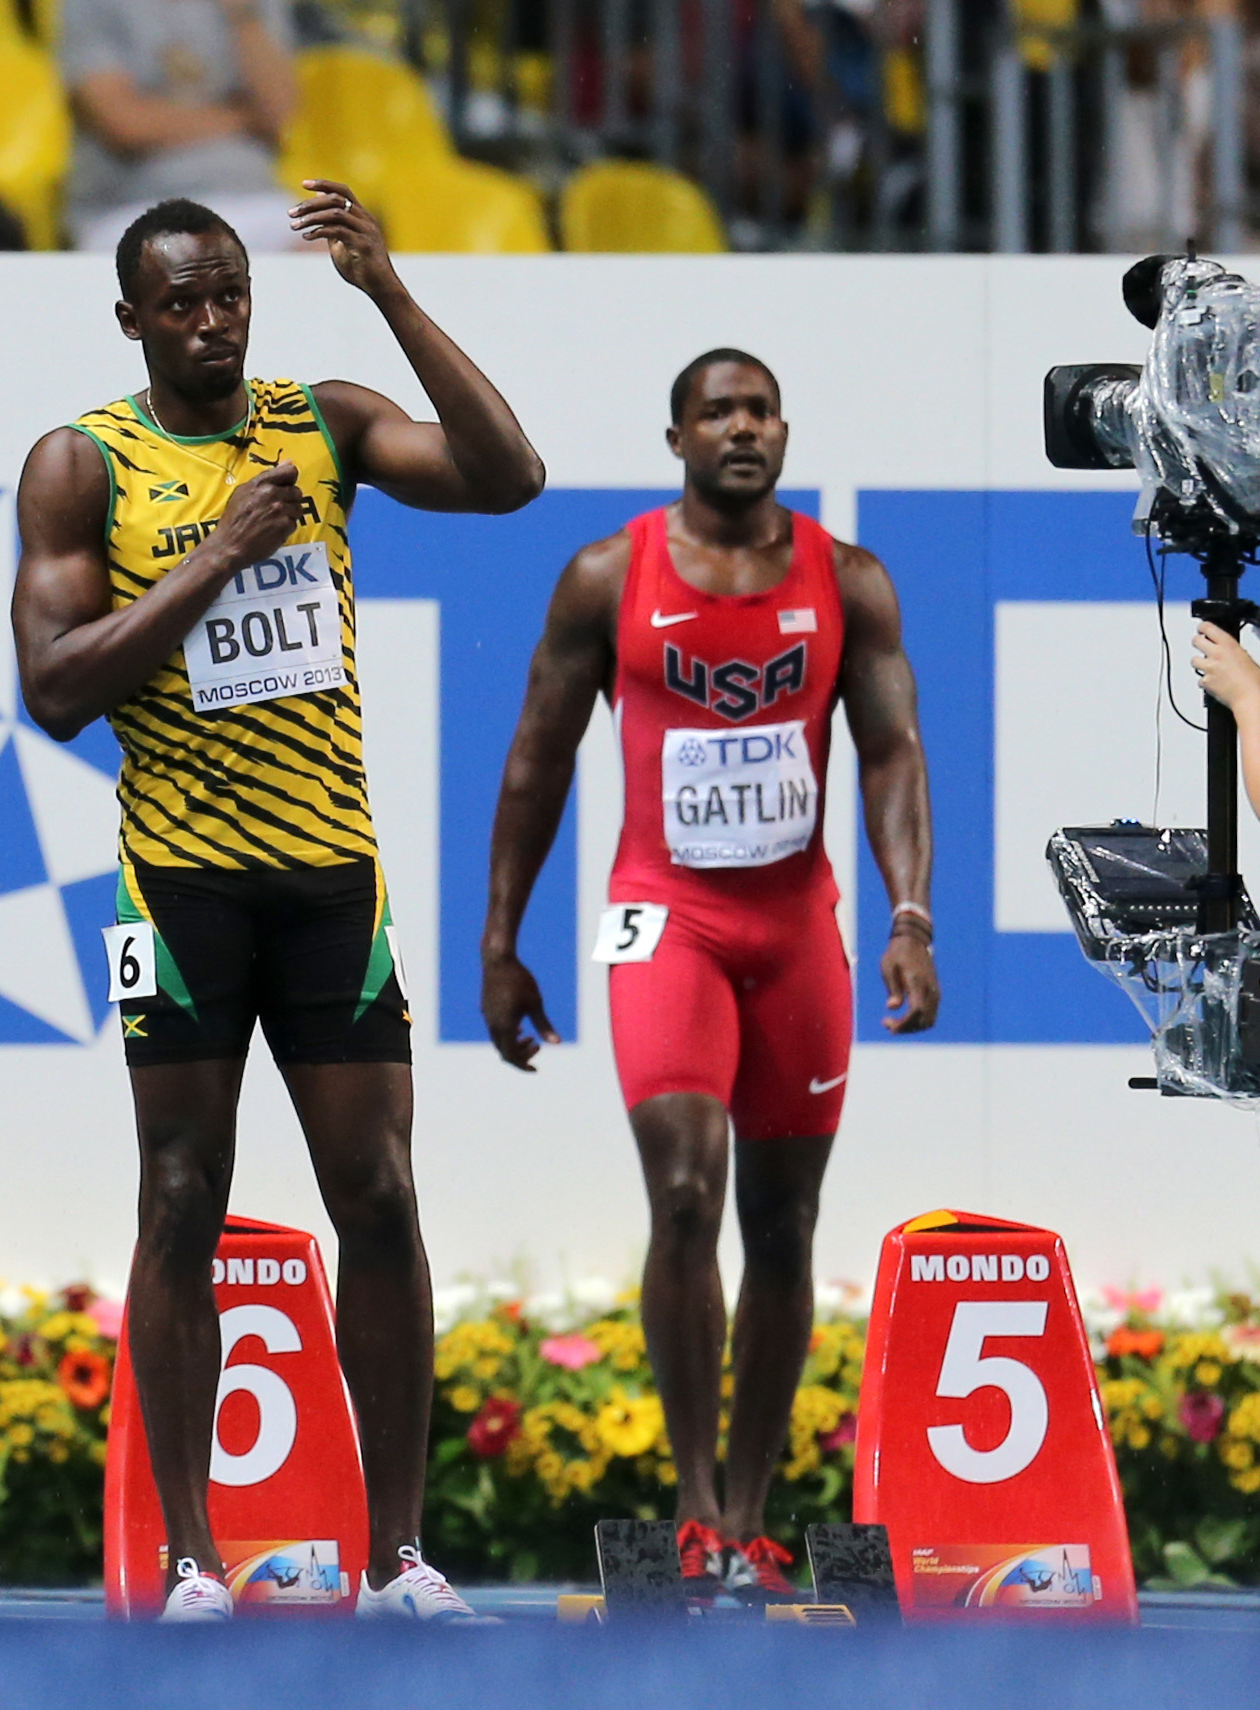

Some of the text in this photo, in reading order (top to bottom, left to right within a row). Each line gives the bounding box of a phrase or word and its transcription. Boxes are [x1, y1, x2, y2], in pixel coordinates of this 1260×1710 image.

[205, 602, 321, 665] BOLT
[198, 666, 341, 703] MOSCOW 2013
[663, 639, 806, 722] USA
[707, 732, 796, 767] TDK
[675, 778, 809, 826] GATLIN
[616, 908, 643, 951] 5
[119, 936, 141, 989] 6
[212, 1258, 307, 1286] ONDO
[910, 1255, 1051, 1283] MONDO
[209, 1304, 303, 1487] 6
[927, 1301, 1048, 1483] 5
[914, 1565, 980, 1575] Championships
